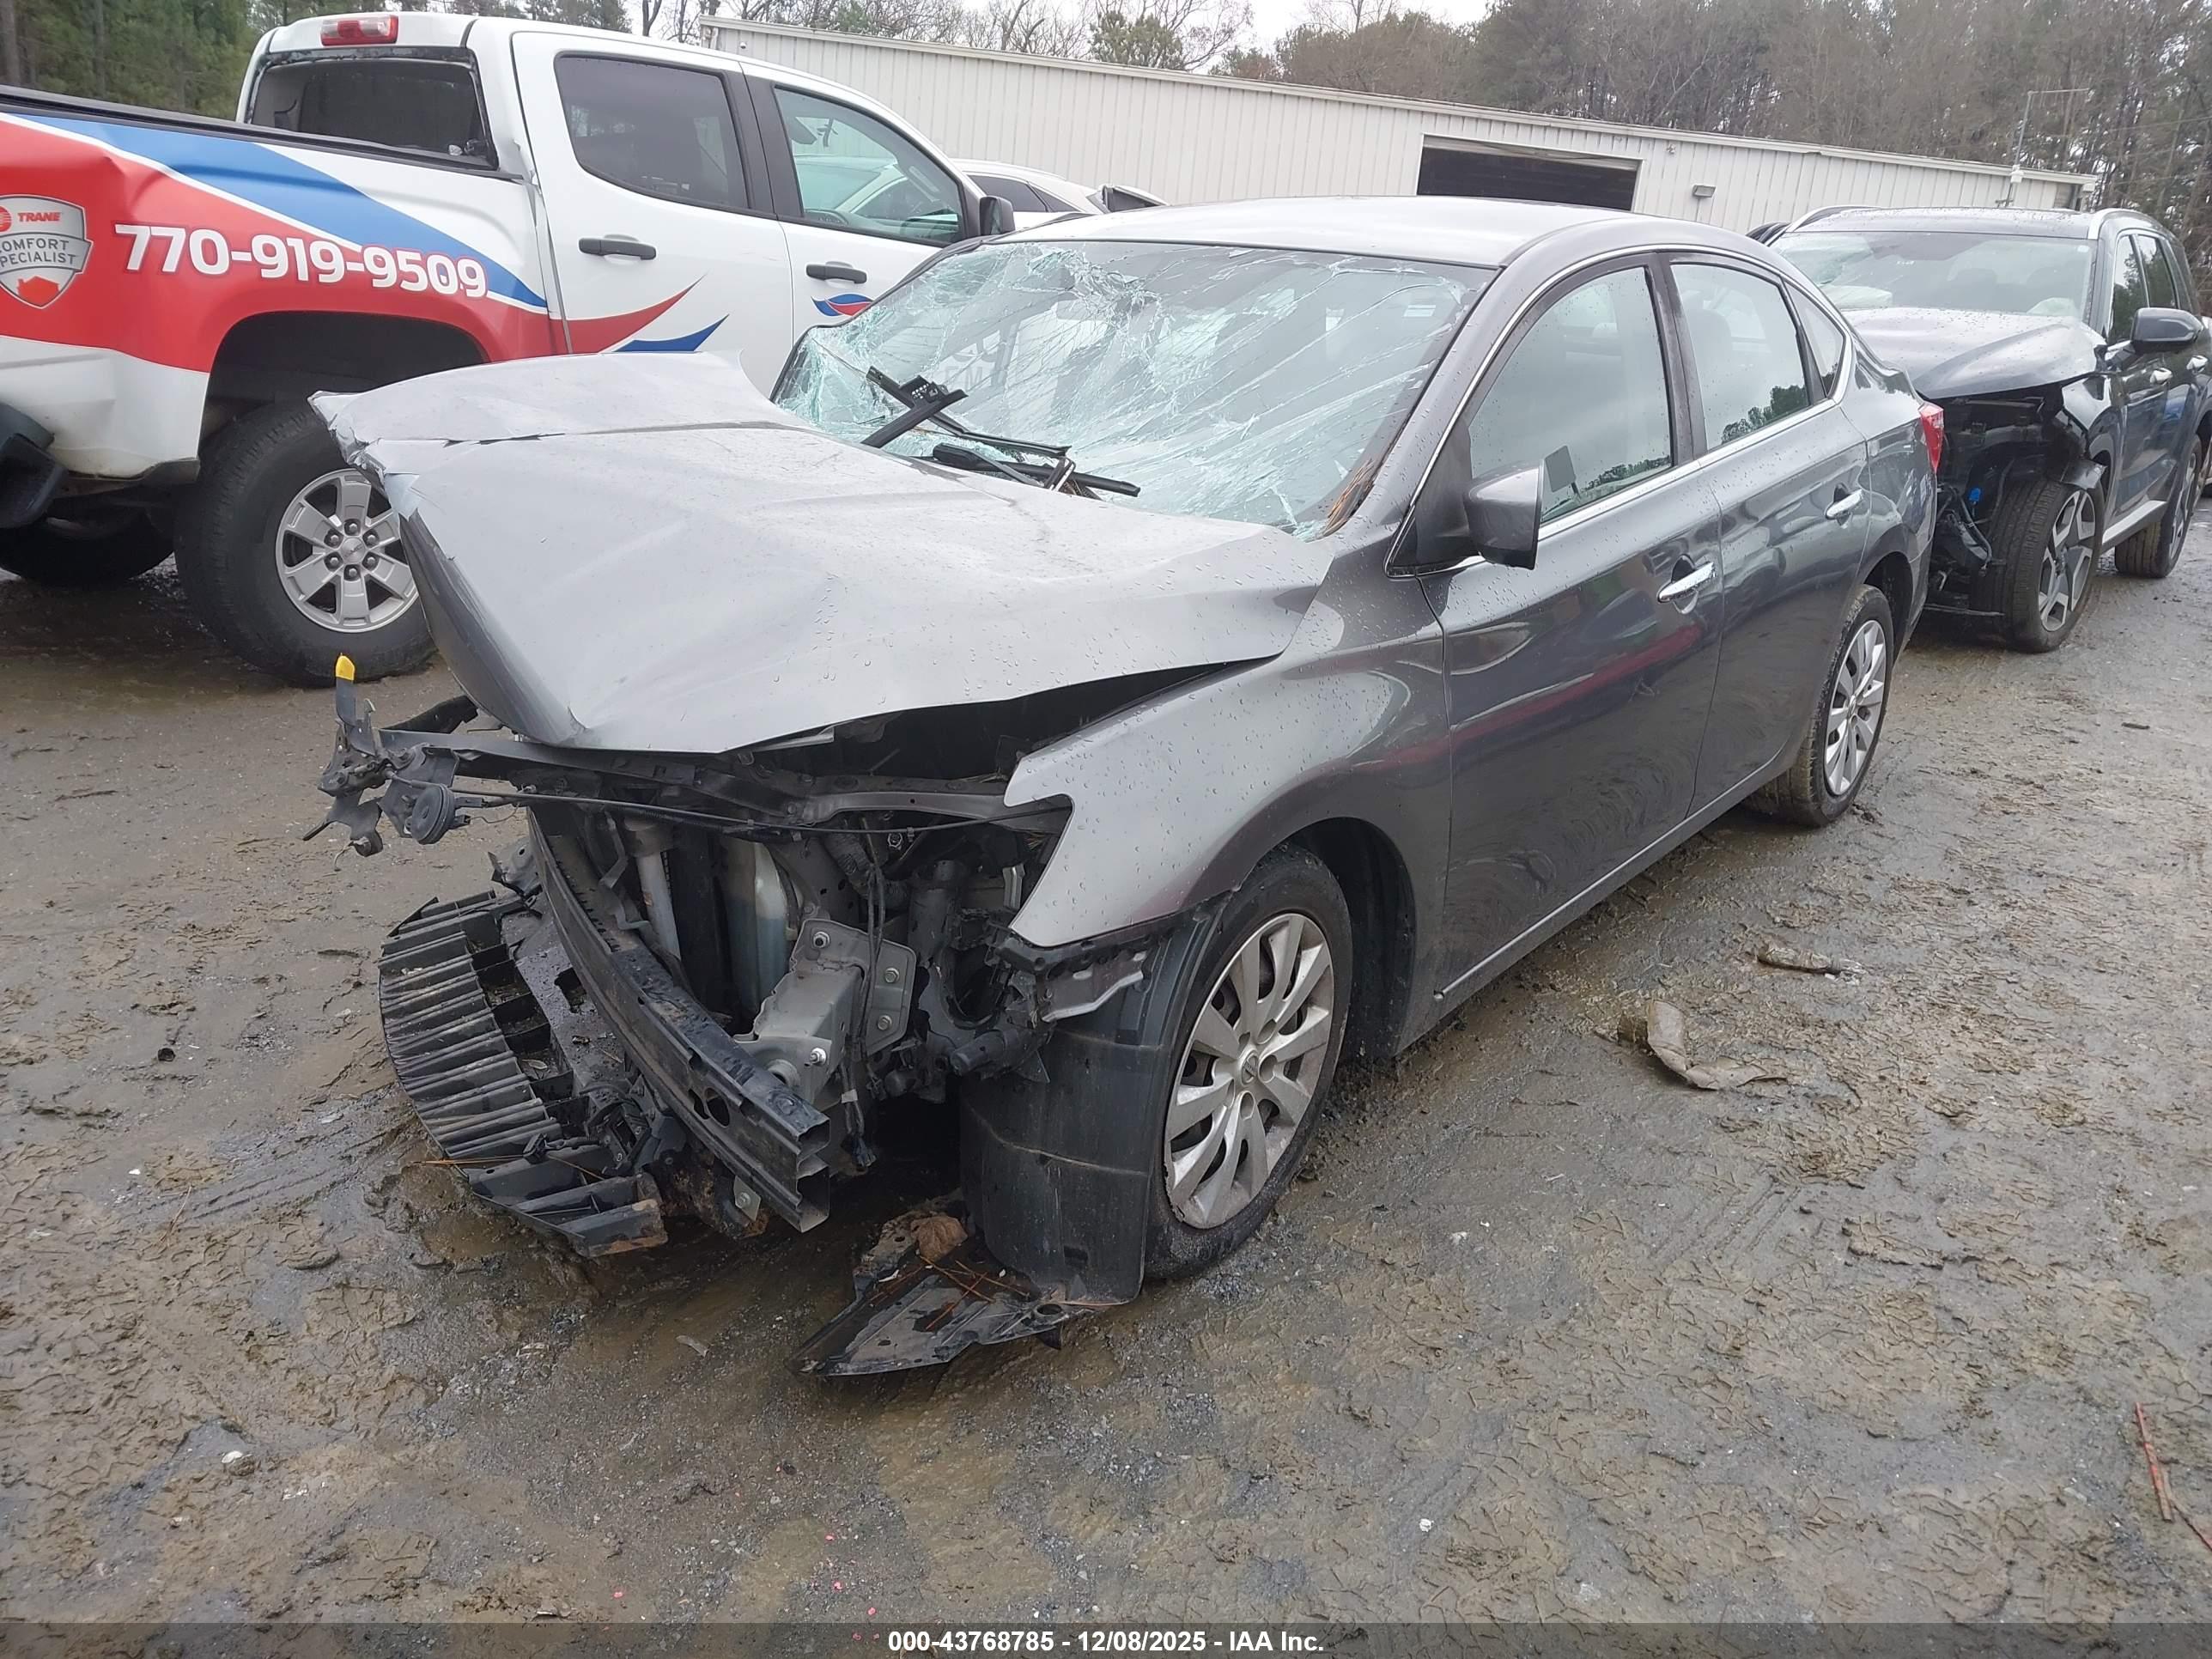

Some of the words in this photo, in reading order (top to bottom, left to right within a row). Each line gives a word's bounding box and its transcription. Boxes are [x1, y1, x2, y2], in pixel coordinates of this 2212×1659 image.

[17, 211, 60, 222] TRANE
[0, 237, 70, 253] OMFORT
[0, 251, 76, 268] PECIALIST
[114, 223, 487, 298] 770-919-9509
